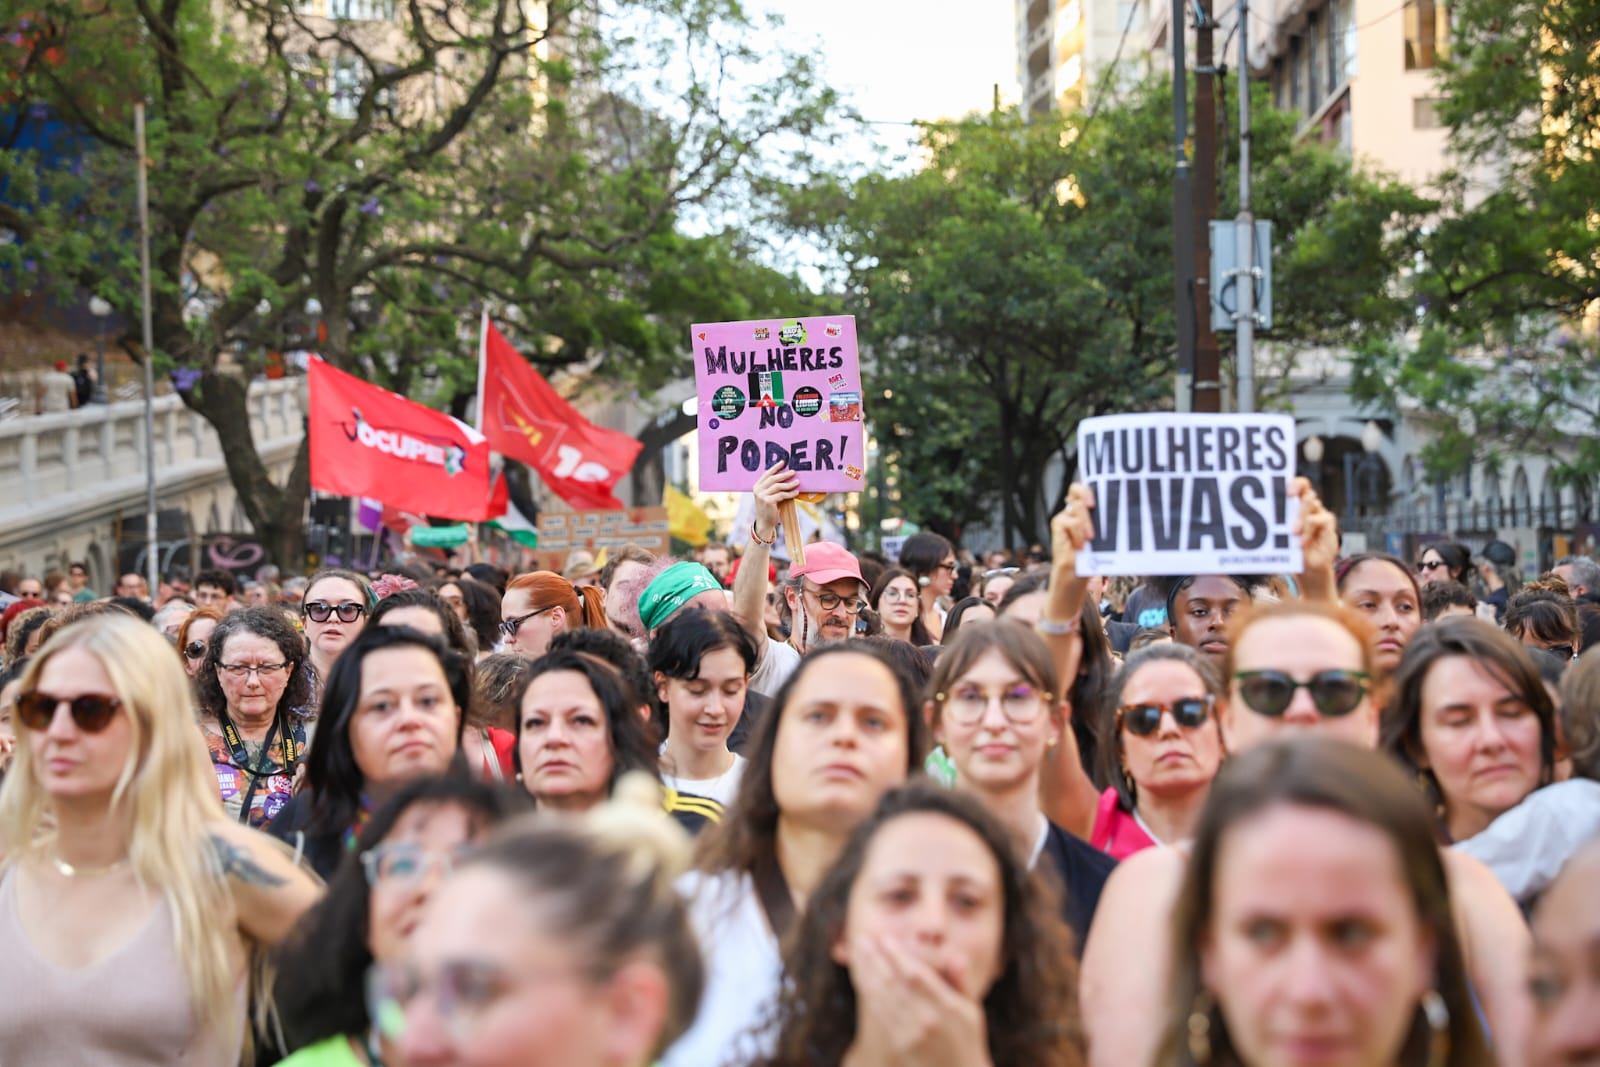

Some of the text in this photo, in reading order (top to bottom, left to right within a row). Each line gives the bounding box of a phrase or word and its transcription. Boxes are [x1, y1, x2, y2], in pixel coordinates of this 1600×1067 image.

[704, 346, 843, 375] MULHERES
[759, 403, 794, 429] NO
[717, 435, 848, 473] PODER!
[1085, 426, 1287, 477] MULHERES
[1088, 475, 1289, 552] VIVAS!
[225, 725, 239, 746] Nikon
[286, 739, 295, 761] Nikon
